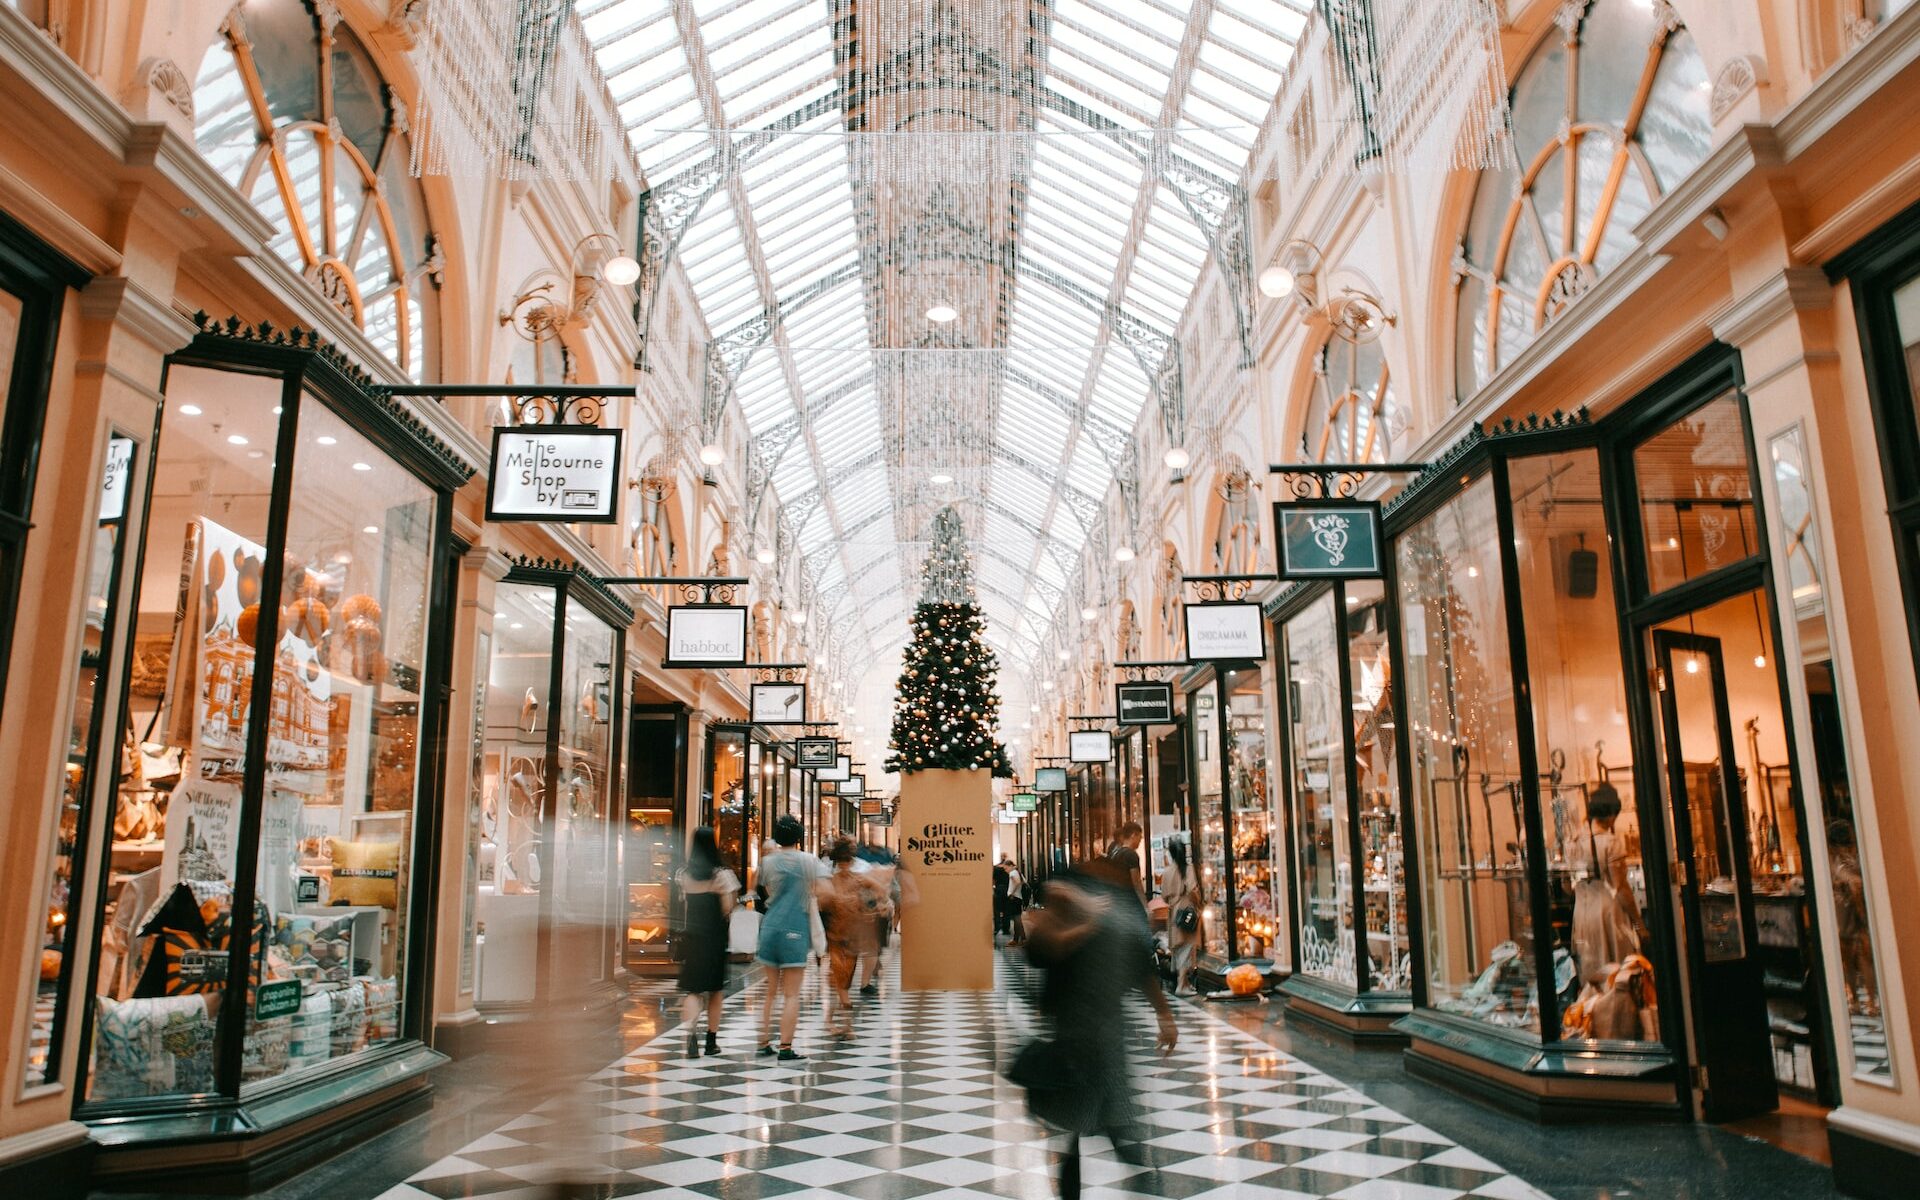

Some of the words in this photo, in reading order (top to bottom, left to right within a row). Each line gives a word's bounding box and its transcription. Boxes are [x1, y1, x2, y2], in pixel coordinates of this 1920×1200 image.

[526, 440, 556, 455] The
[507, 453, 603, 469] Melbourne
[521, 471, 566, 490] Shop
[537, 488, 558, 507] by
[1197, 630, 1248, 641] CHOCAMAMA
[907, 836, 963, 852] Sparkle
